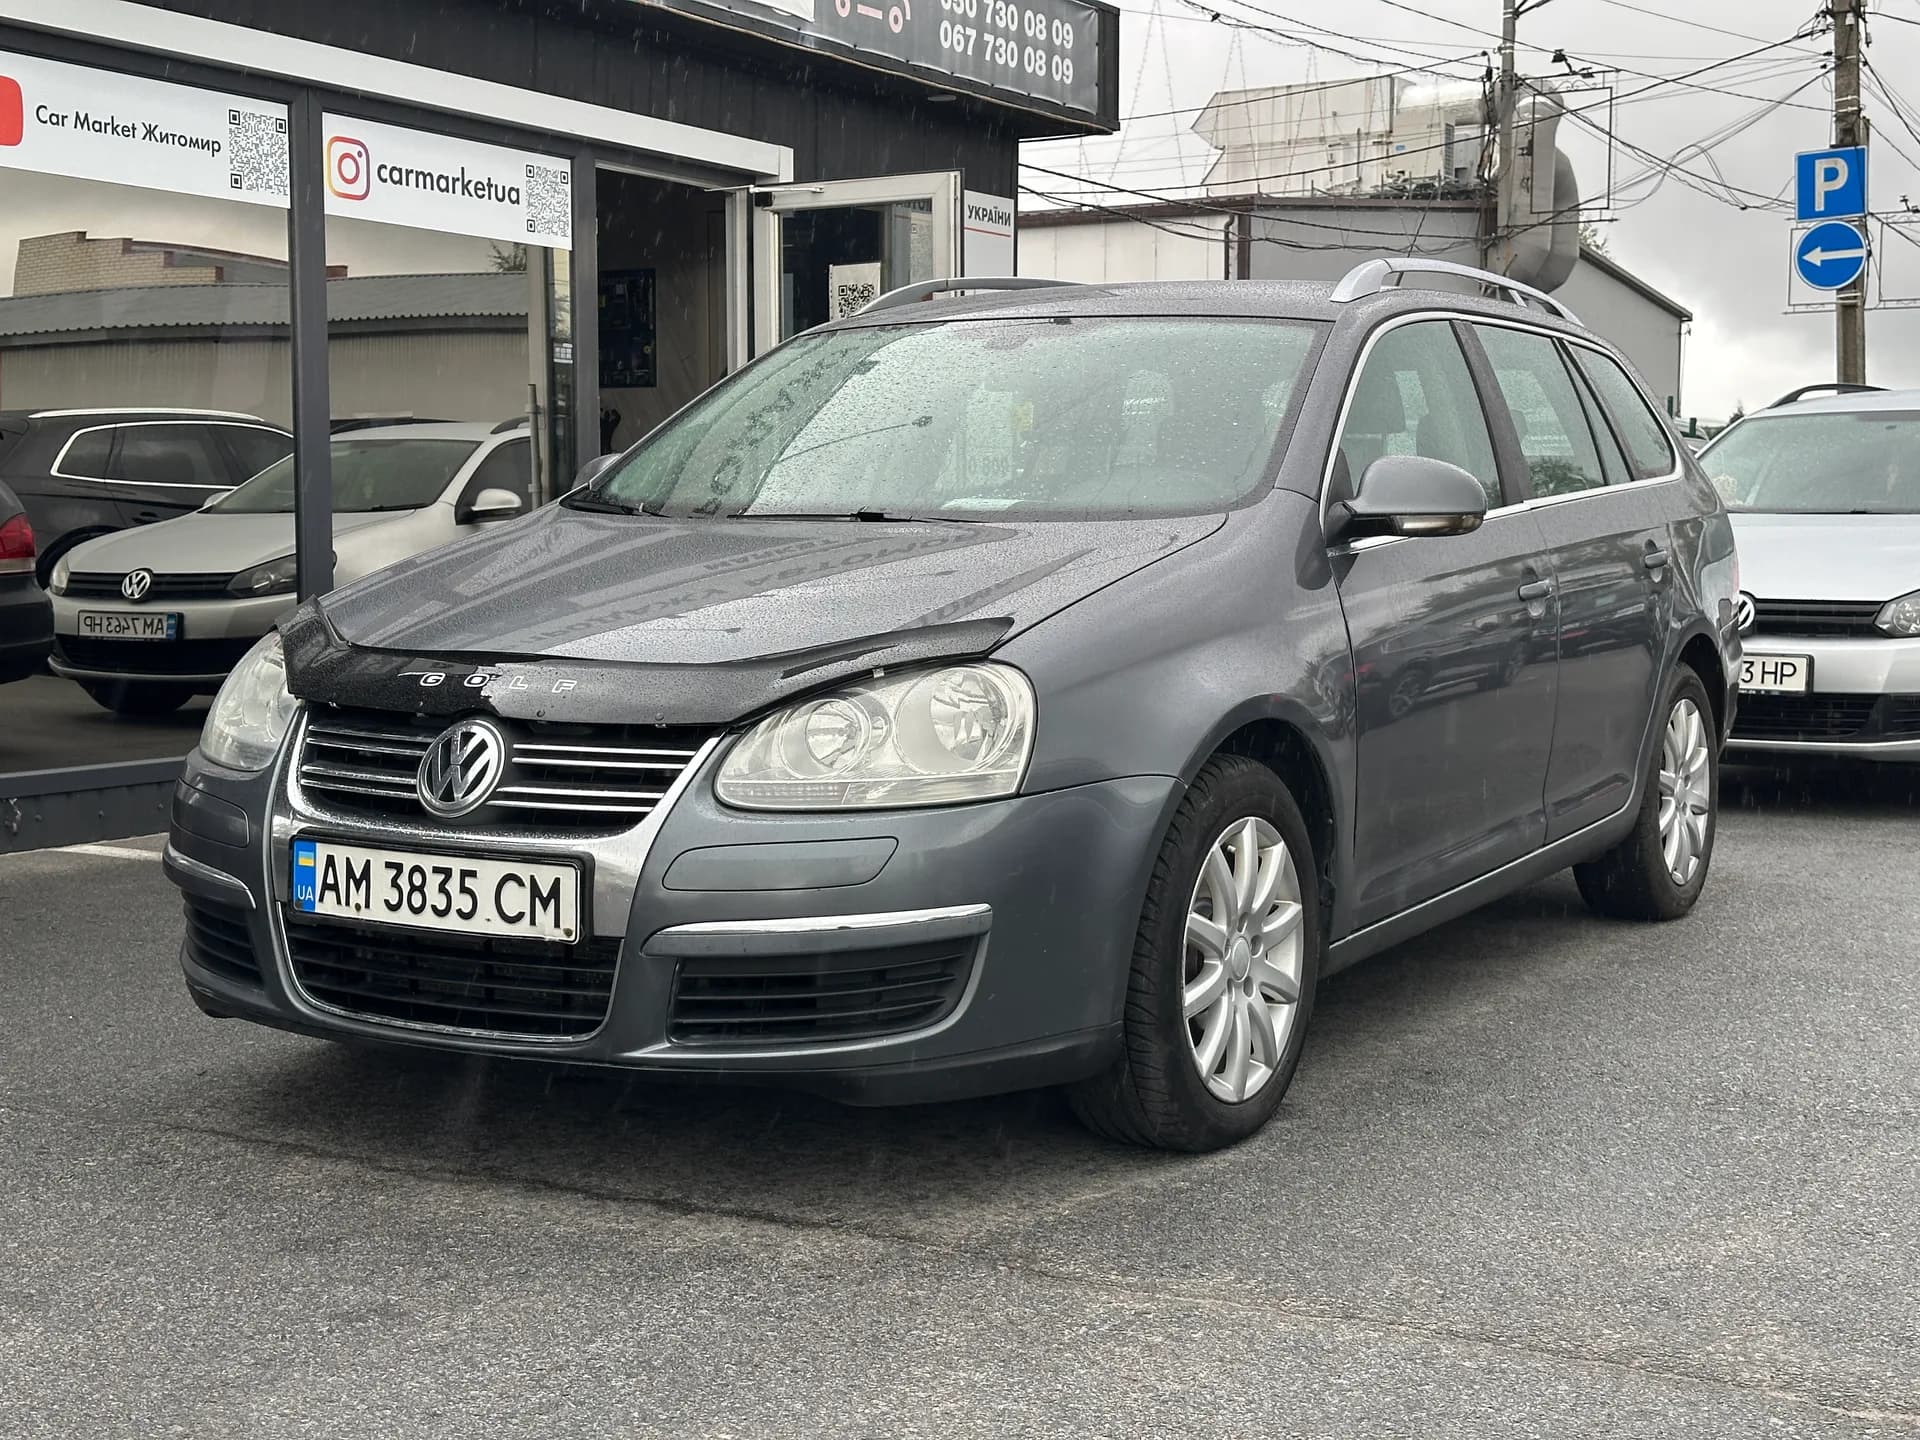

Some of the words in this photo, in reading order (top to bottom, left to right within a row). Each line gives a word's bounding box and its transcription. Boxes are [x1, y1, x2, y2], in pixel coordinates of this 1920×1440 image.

[984, 0, 1018, 31] 730
[1024, 10, 1047, 40] 08
[1052, 19, 1073, 49] 09
[940, 20, 977, 56] 067
[984, 33, 1018, 68] 730
[1024, 46, 1047, 77] 08
[1052, 55, 1073, 84] 09
[35, 105, 69, 128] Car
[73, 112, 137, 138] Market
[141, 122, 222, 155] Житомир
[376, 161, 520, 206] carmarketua
[1814, 157, 1848, 211] P
[967, 203, 1012, 227] УКРАЇНИ
[419, 673, 577, 693] GOLF
[1760, 661, 1797, 685] HP
[297, 884, 314, 901] UA
[318, 853, 372, 909] AM
[383, 860, 478, 921] 3835
[494, 872, 562, 930] CM
